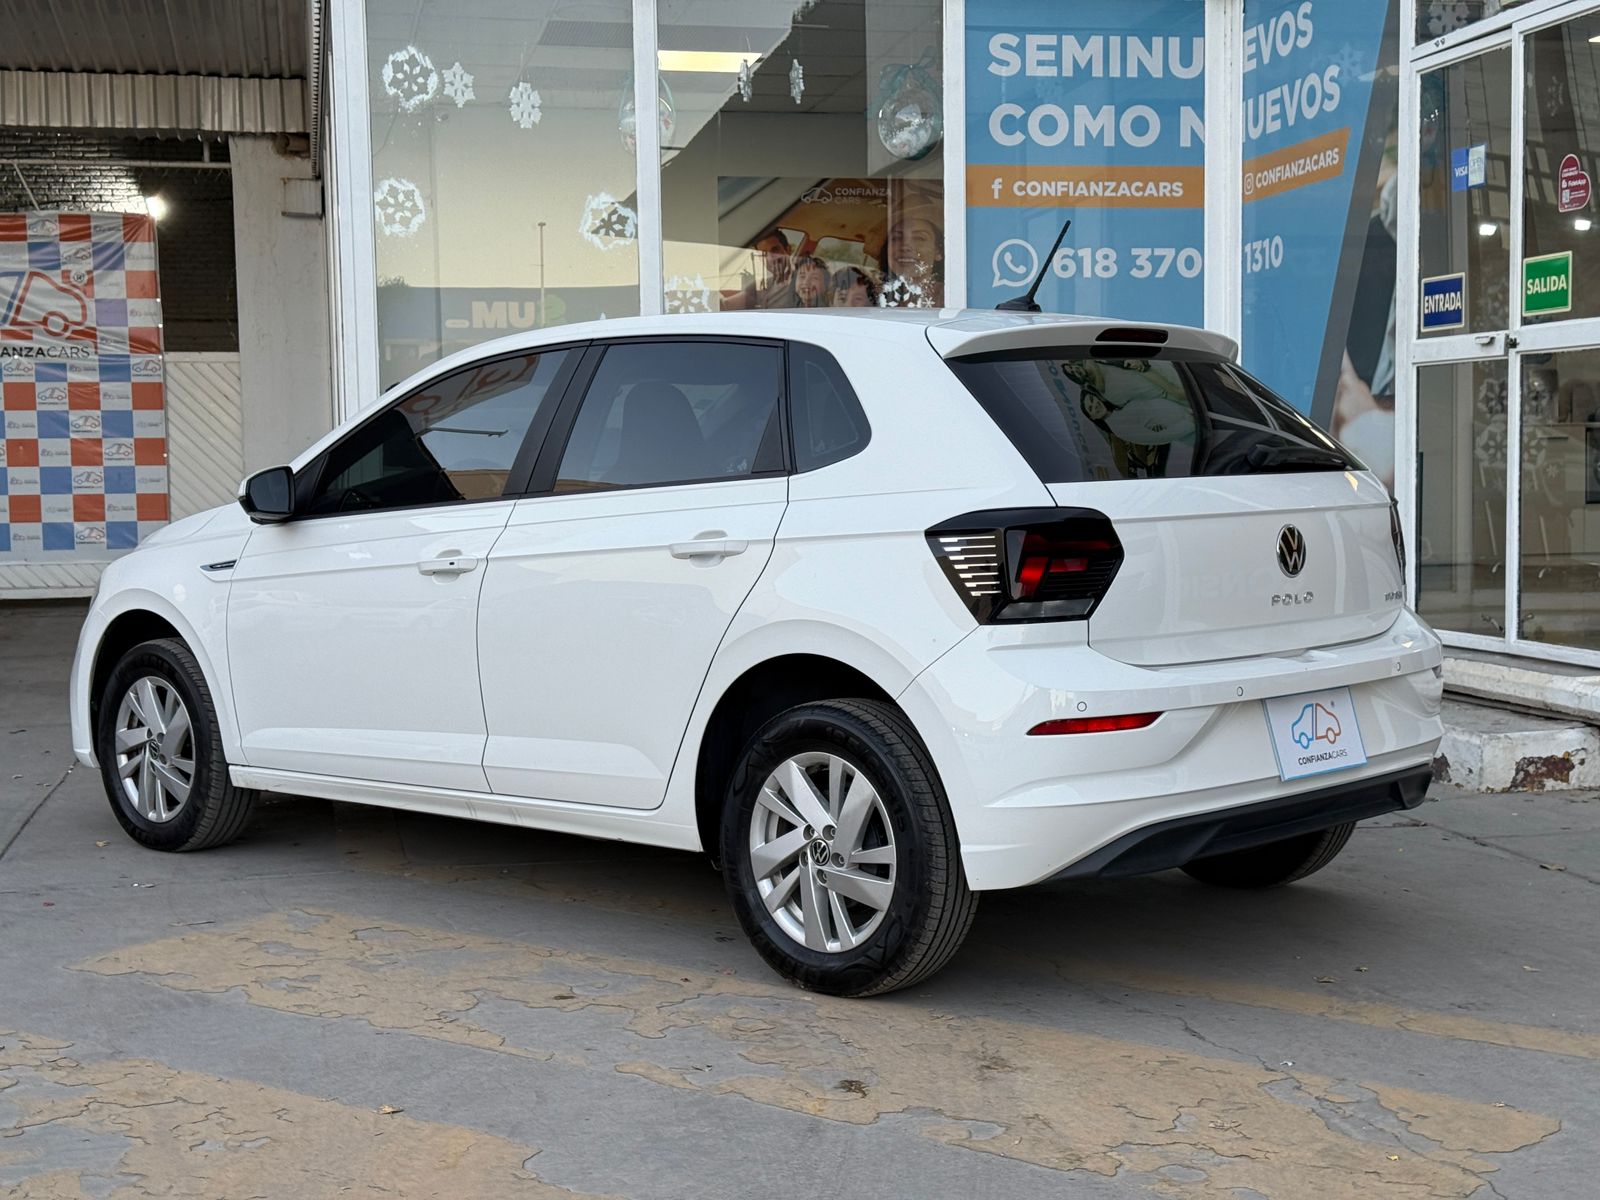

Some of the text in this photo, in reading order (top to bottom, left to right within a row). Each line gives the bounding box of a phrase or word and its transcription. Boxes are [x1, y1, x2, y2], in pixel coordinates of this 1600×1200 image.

[988, 103, 1161, 147] COMO
[1255, 148, 1340, 189] CONFIANZACARS
[1012, 180, 1184, 198] CONFIANZACARS
[1052, 247, 1203, 279] 618 370
[1244, 235, 1284, 274] 1310
[1526, 274, 1568, 295] SALIDA
[1424, 291, 1462, 314] ENTRADA
[1271, 591, 1314, 606] POLO
[1298, 748, 1348, 765] CONFIANZACARS
